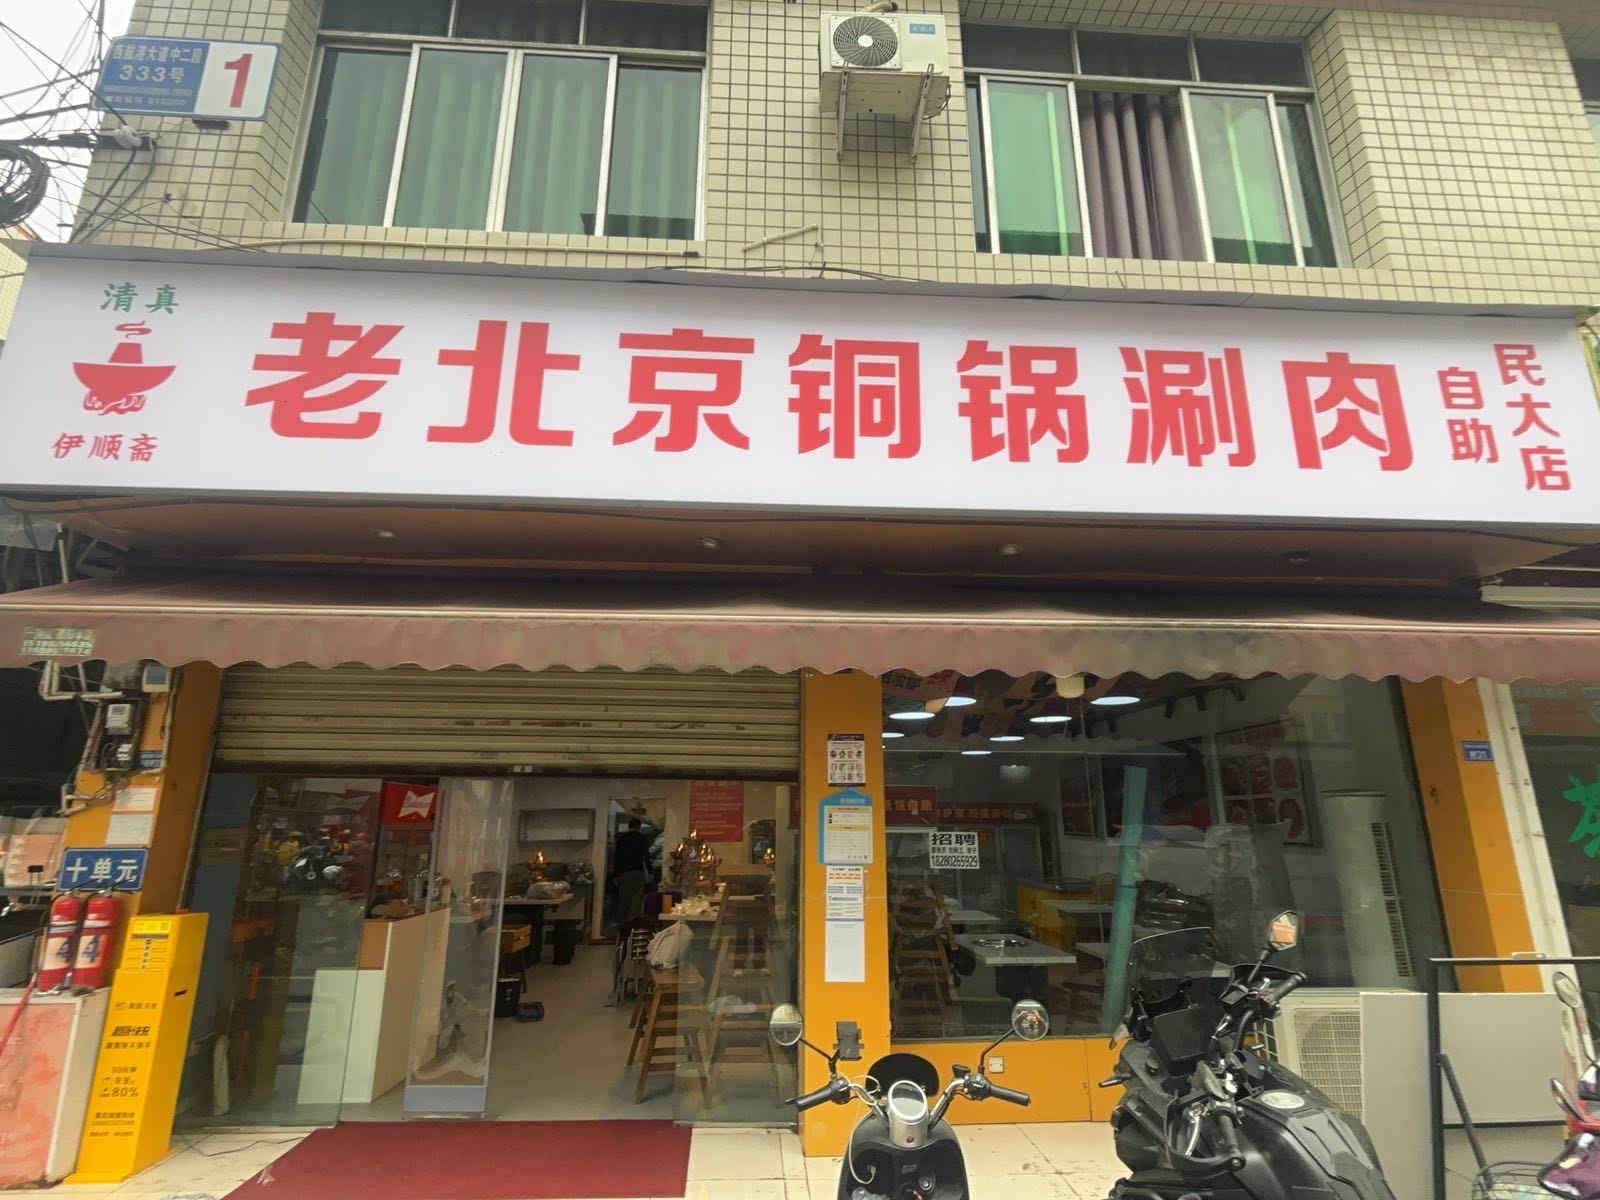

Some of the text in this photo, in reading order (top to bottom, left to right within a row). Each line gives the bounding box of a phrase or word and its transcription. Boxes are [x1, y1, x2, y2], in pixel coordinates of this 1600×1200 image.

[119, 64, 184, 84] 333号
[223, 53, 253, 108] 1
[100, 282, 180, 315] 清真
[244, 311, 1415, 472] 老北京铜锅涮肉
[1436, 366, 1500, 465] 自助
[1493, 343, 1573, 492] 民大店
[51, 431, 159, 463] 伊顺斋
[931, 833, 976, 846] 招聘
[66, 857, 138, 883] 十单元
[111, 1087, 139, 1098] 80%
